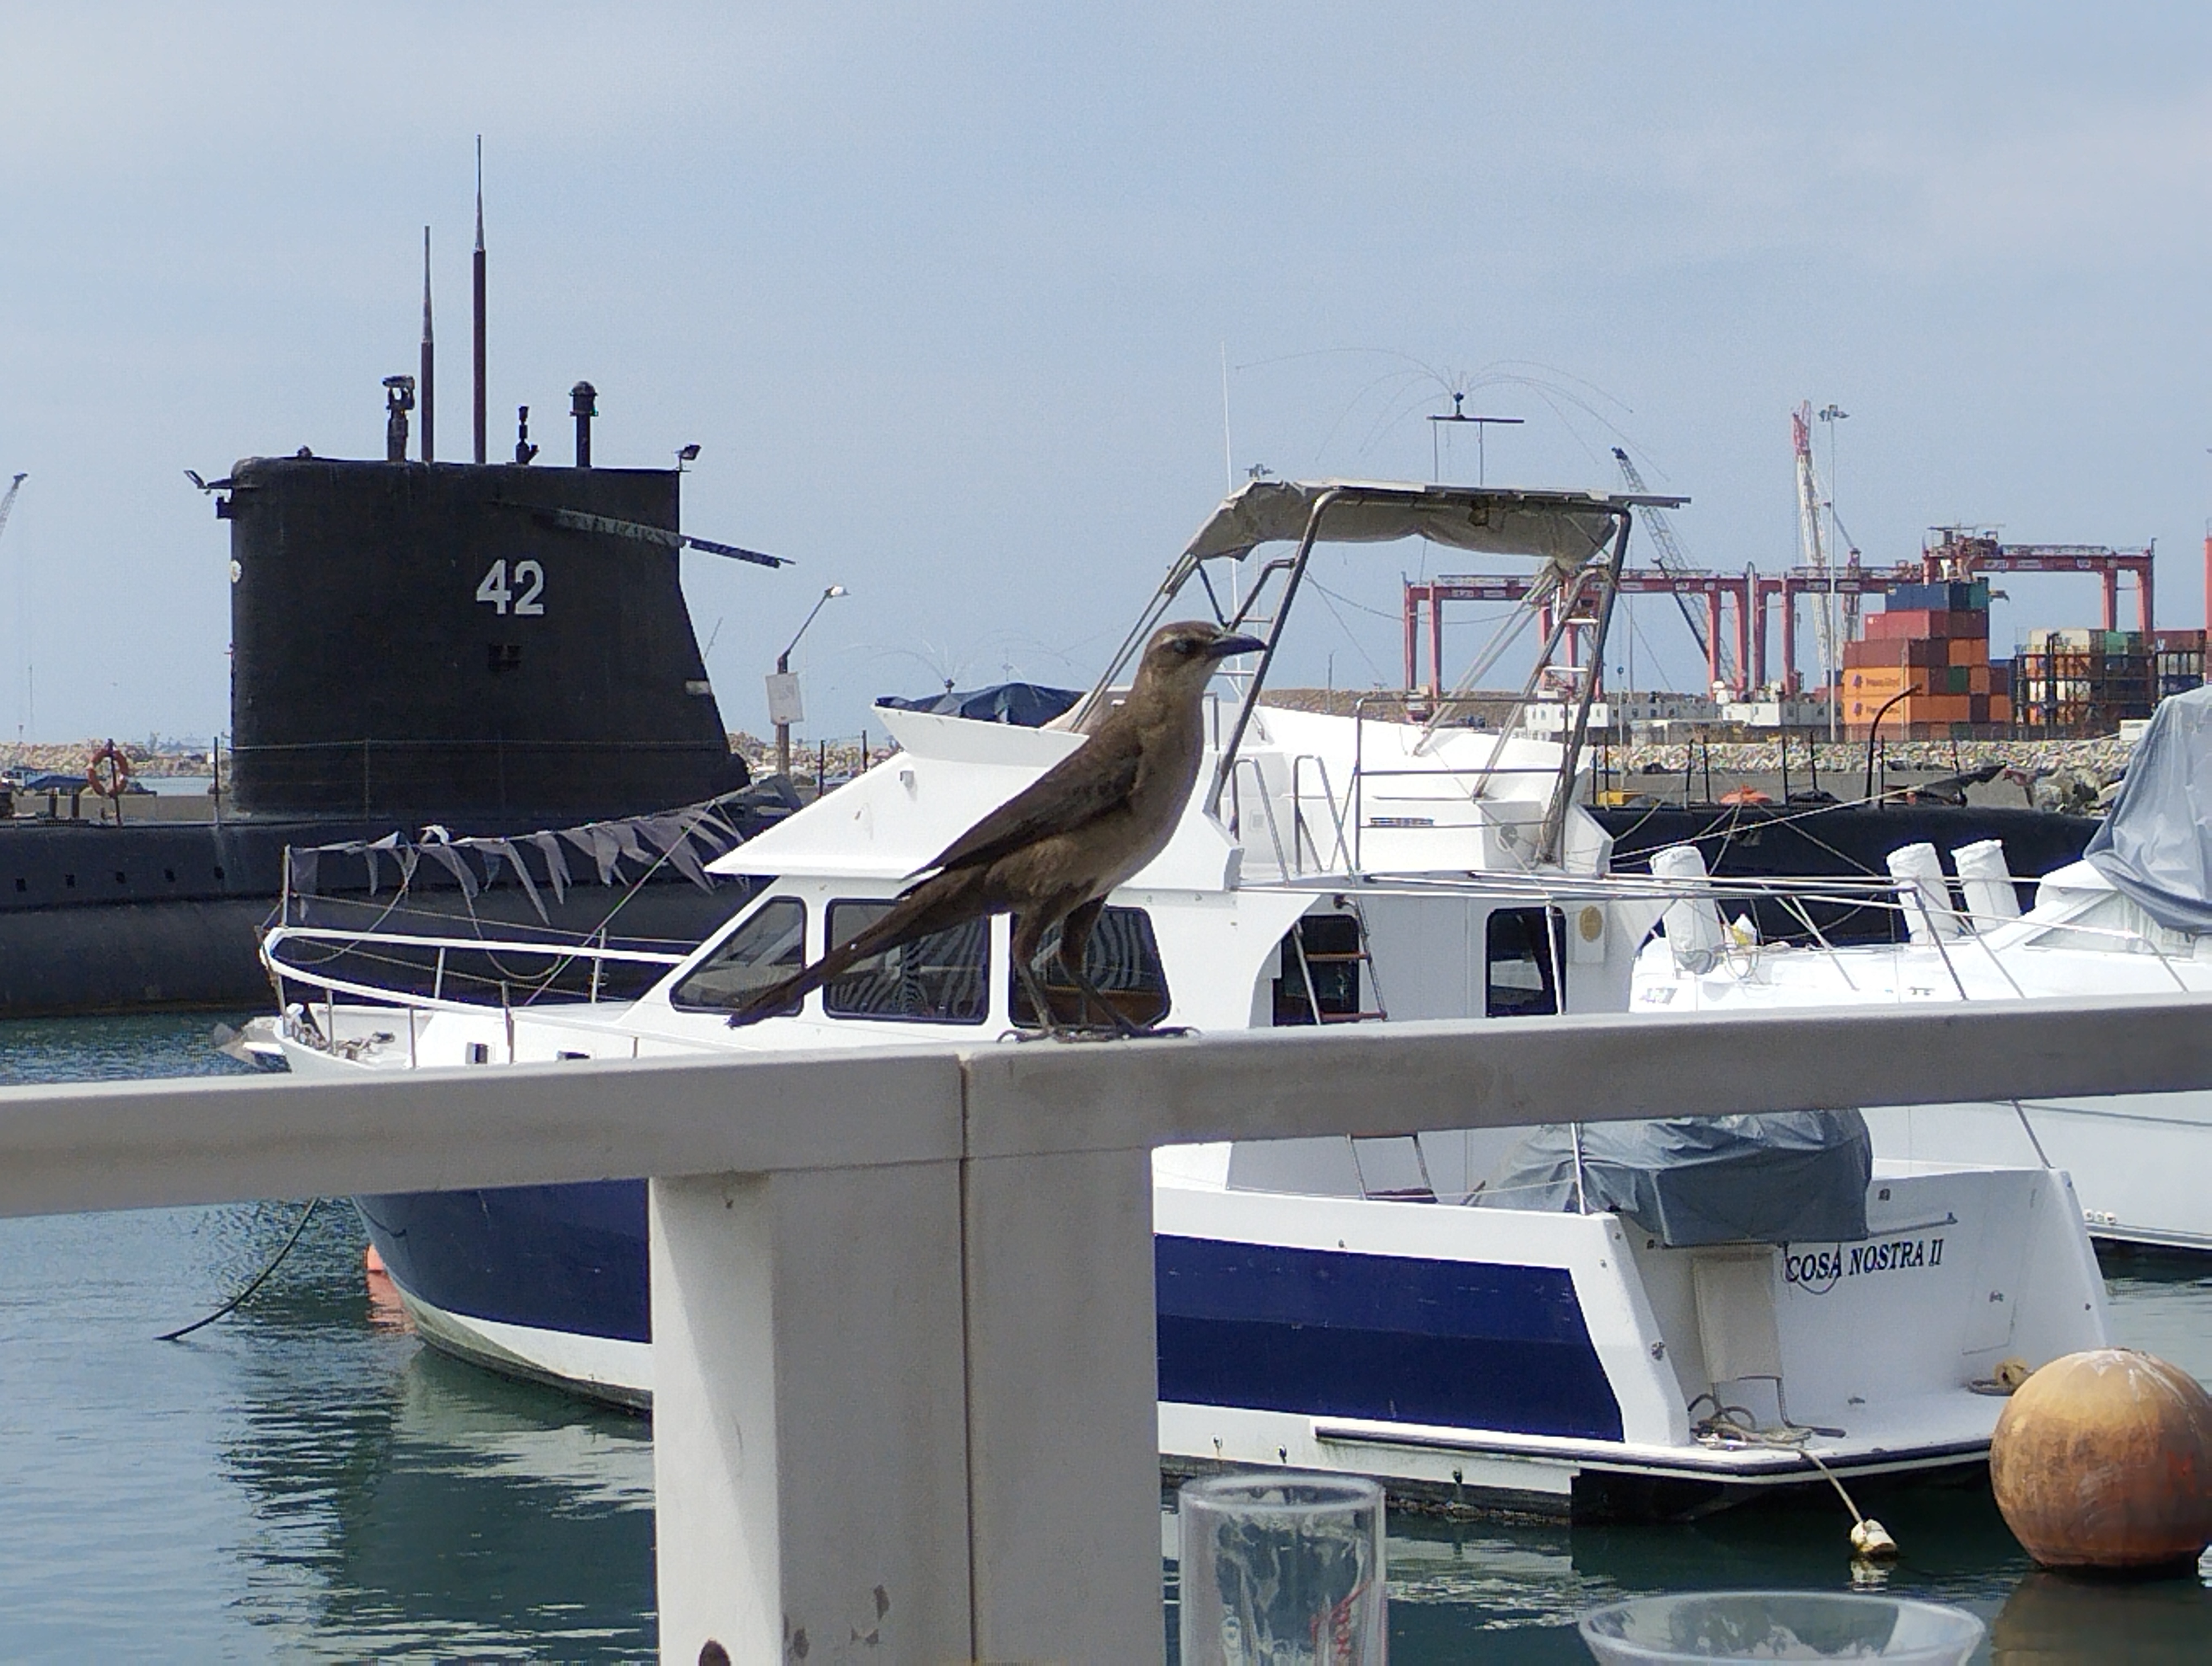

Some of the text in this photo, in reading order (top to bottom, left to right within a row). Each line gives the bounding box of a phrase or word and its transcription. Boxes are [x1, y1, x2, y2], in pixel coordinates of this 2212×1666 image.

[476, 559, 544, 614] 42
[1785, 1239, 1944, 1282] COSA NOSTRA II
